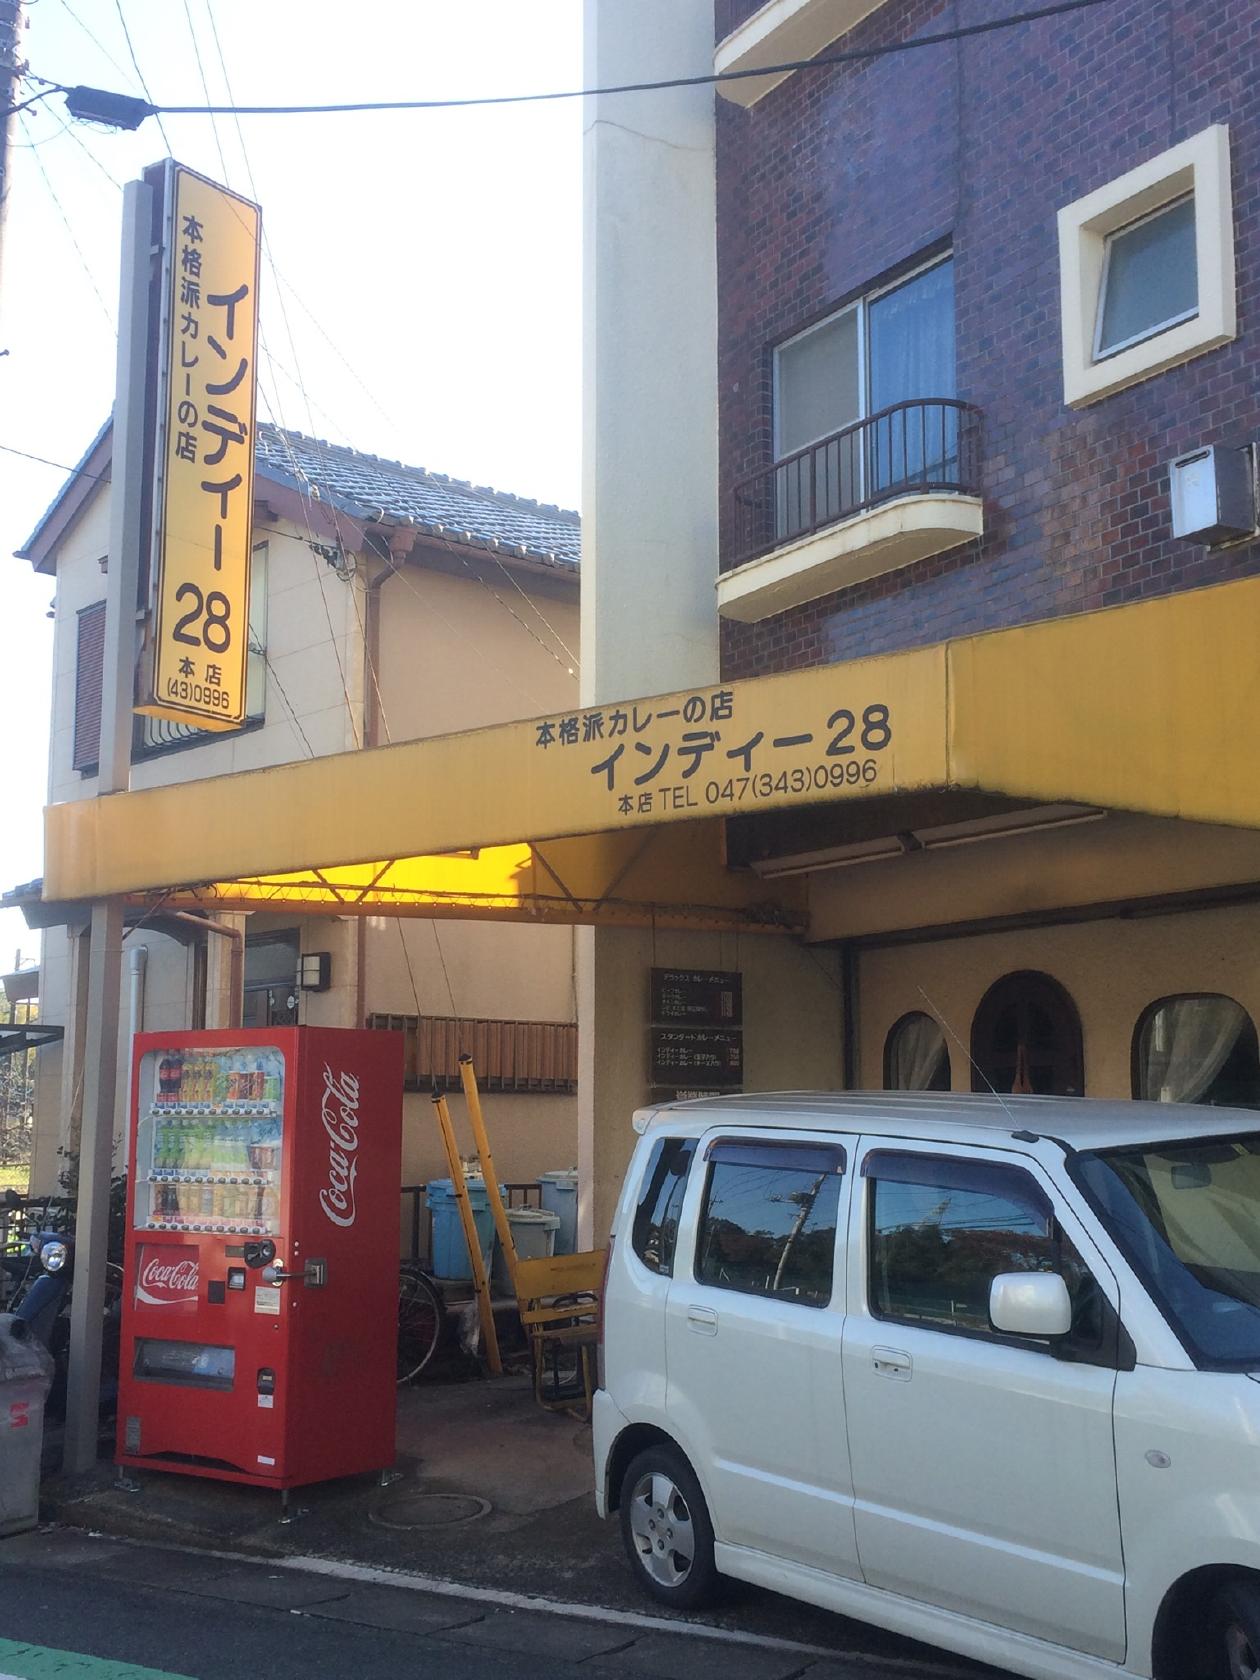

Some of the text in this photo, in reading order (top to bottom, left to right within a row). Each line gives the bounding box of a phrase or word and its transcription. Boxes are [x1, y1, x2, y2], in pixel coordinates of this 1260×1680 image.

[176, 215, 203, 463] 本格派カレーの店
[167, 682, 229, 709] (43)0996
[179, 656, 221, 687] 本店
[536, 691, 734, 749] 本格派カレーの店
[618, 758, 877, 815] 本店 TEL 047(343)0996
[319, 1061, 360, 1227] Coca-Cola
[143, 1258, 199, 1290] Coca-Cola
